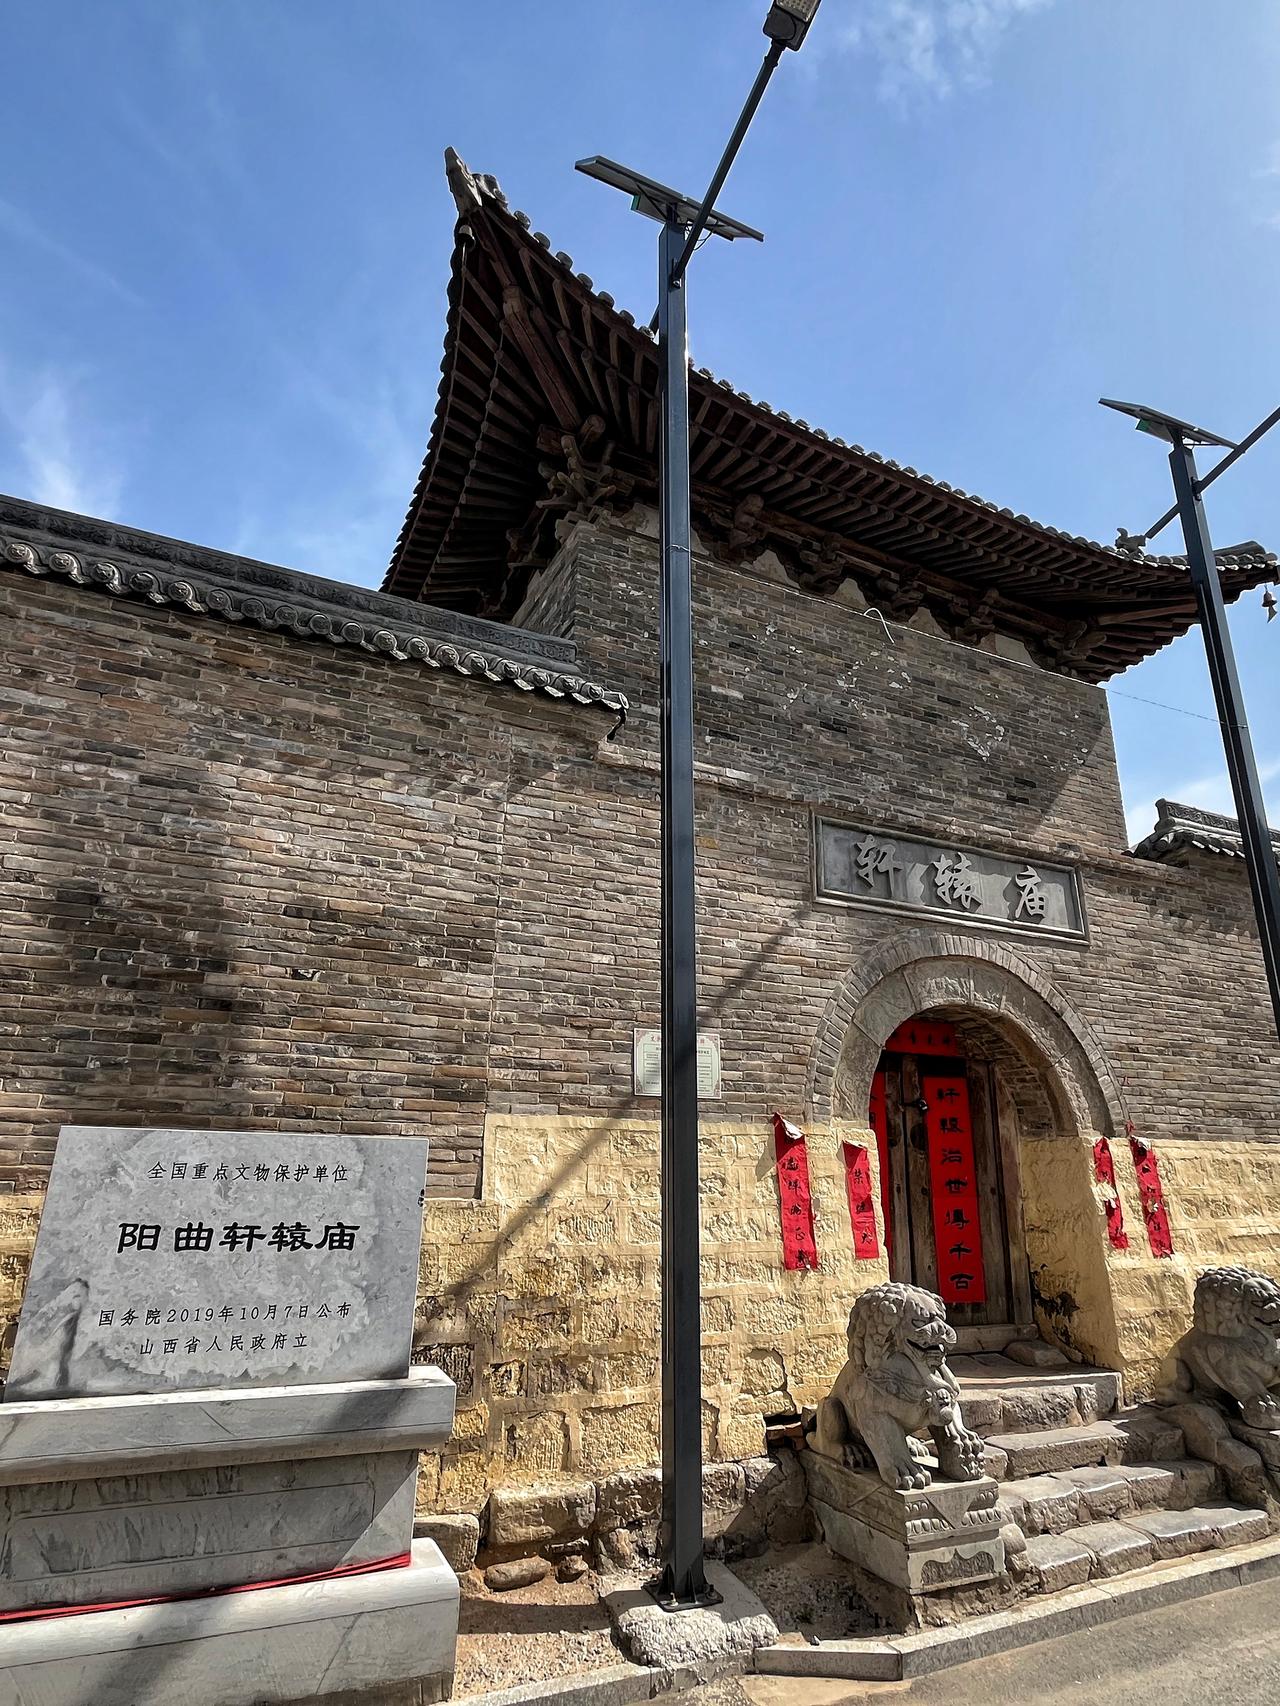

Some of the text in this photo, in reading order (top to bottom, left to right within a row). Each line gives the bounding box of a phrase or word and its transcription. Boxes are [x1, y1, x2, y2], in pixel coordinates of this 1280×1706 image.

[147, 1160, 350, 1184] 全国重点文物保护单位
[117, 1221, 361, 1254] 阳曲轩辕庙
[98, 1302, 352, 1327] 国务院2019年10月7日公布
[139, 1332, 309, 1356] 山西省人民政府立
